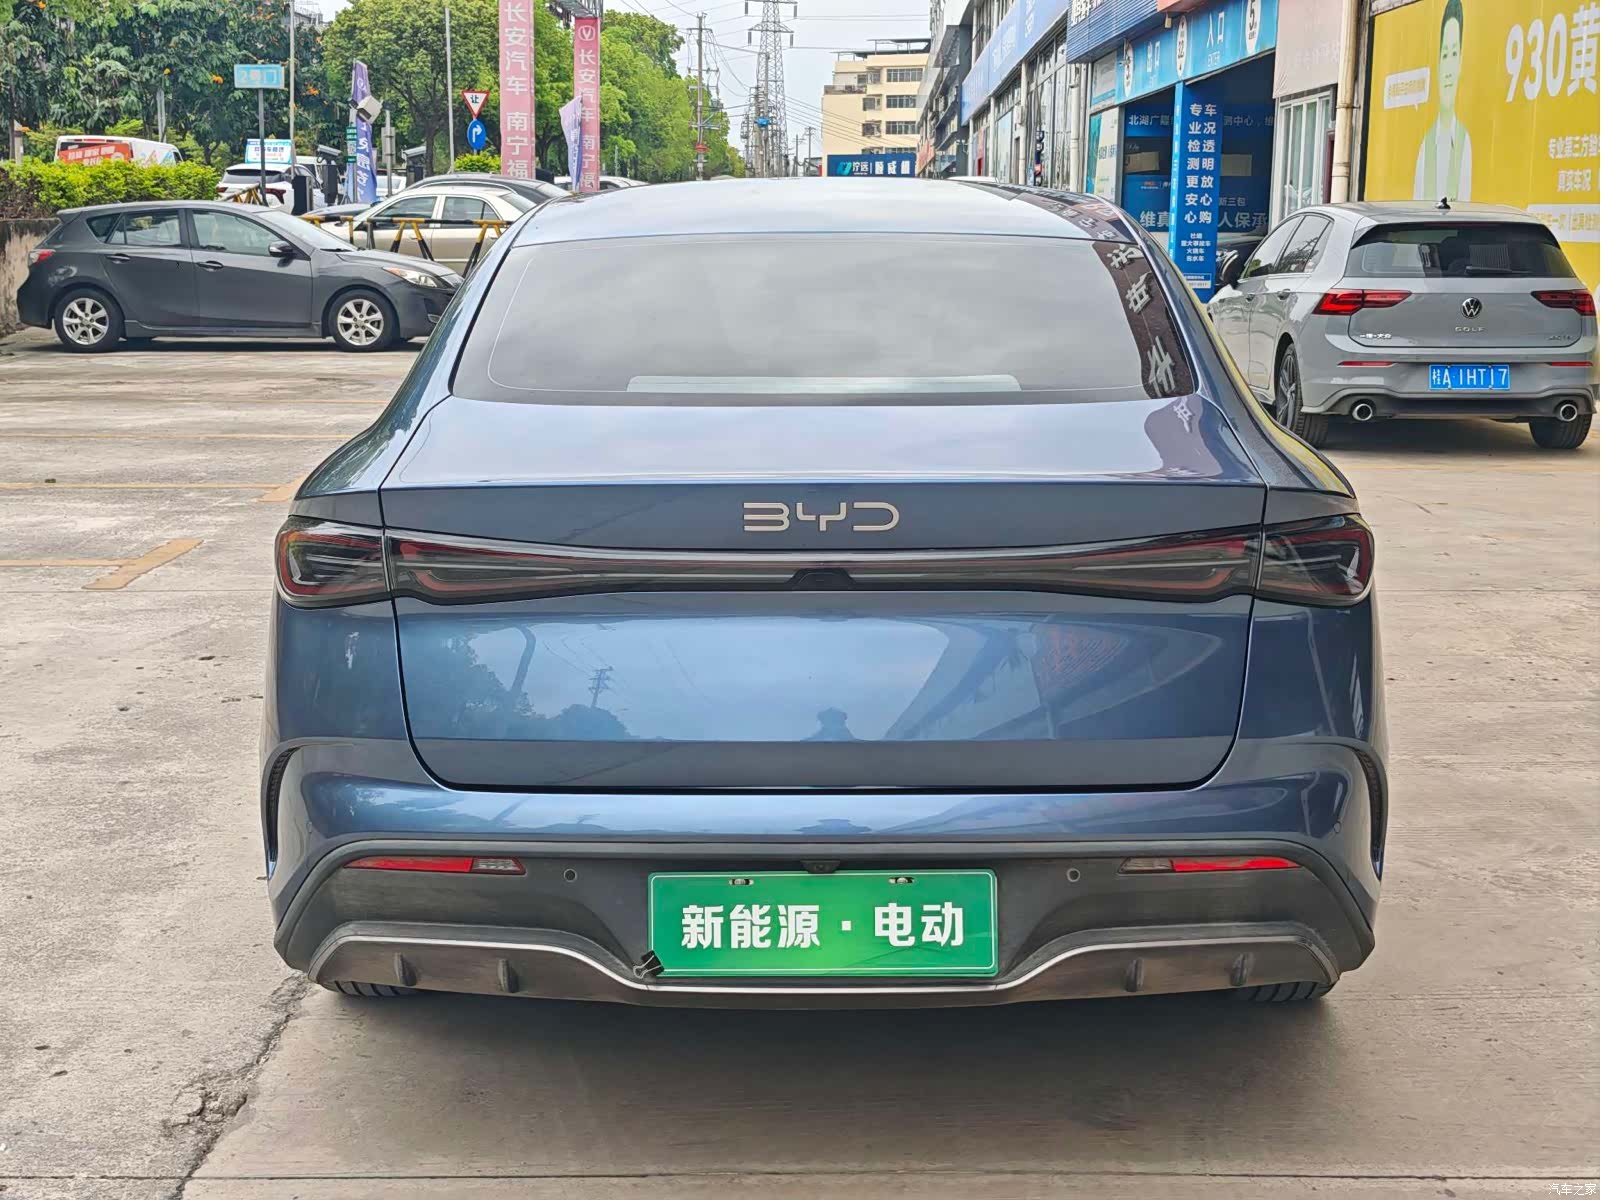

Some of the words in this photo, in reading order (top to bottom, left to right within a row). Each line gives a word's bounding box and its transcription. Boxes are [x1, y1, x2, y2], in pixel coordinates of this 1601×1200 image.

[505, 2, 528, 96] 长安汽车
[1206, 11, 1224, 48] 入口
[470, 94, 480, 103] 让
[506, 112, 528, 178] 南宁福
[1184, 103, 1203, 224] 专业检测更安心
[1199, 104, 1217, 224] 车况透明放心购
[743, 502, 900, 532] BYD
